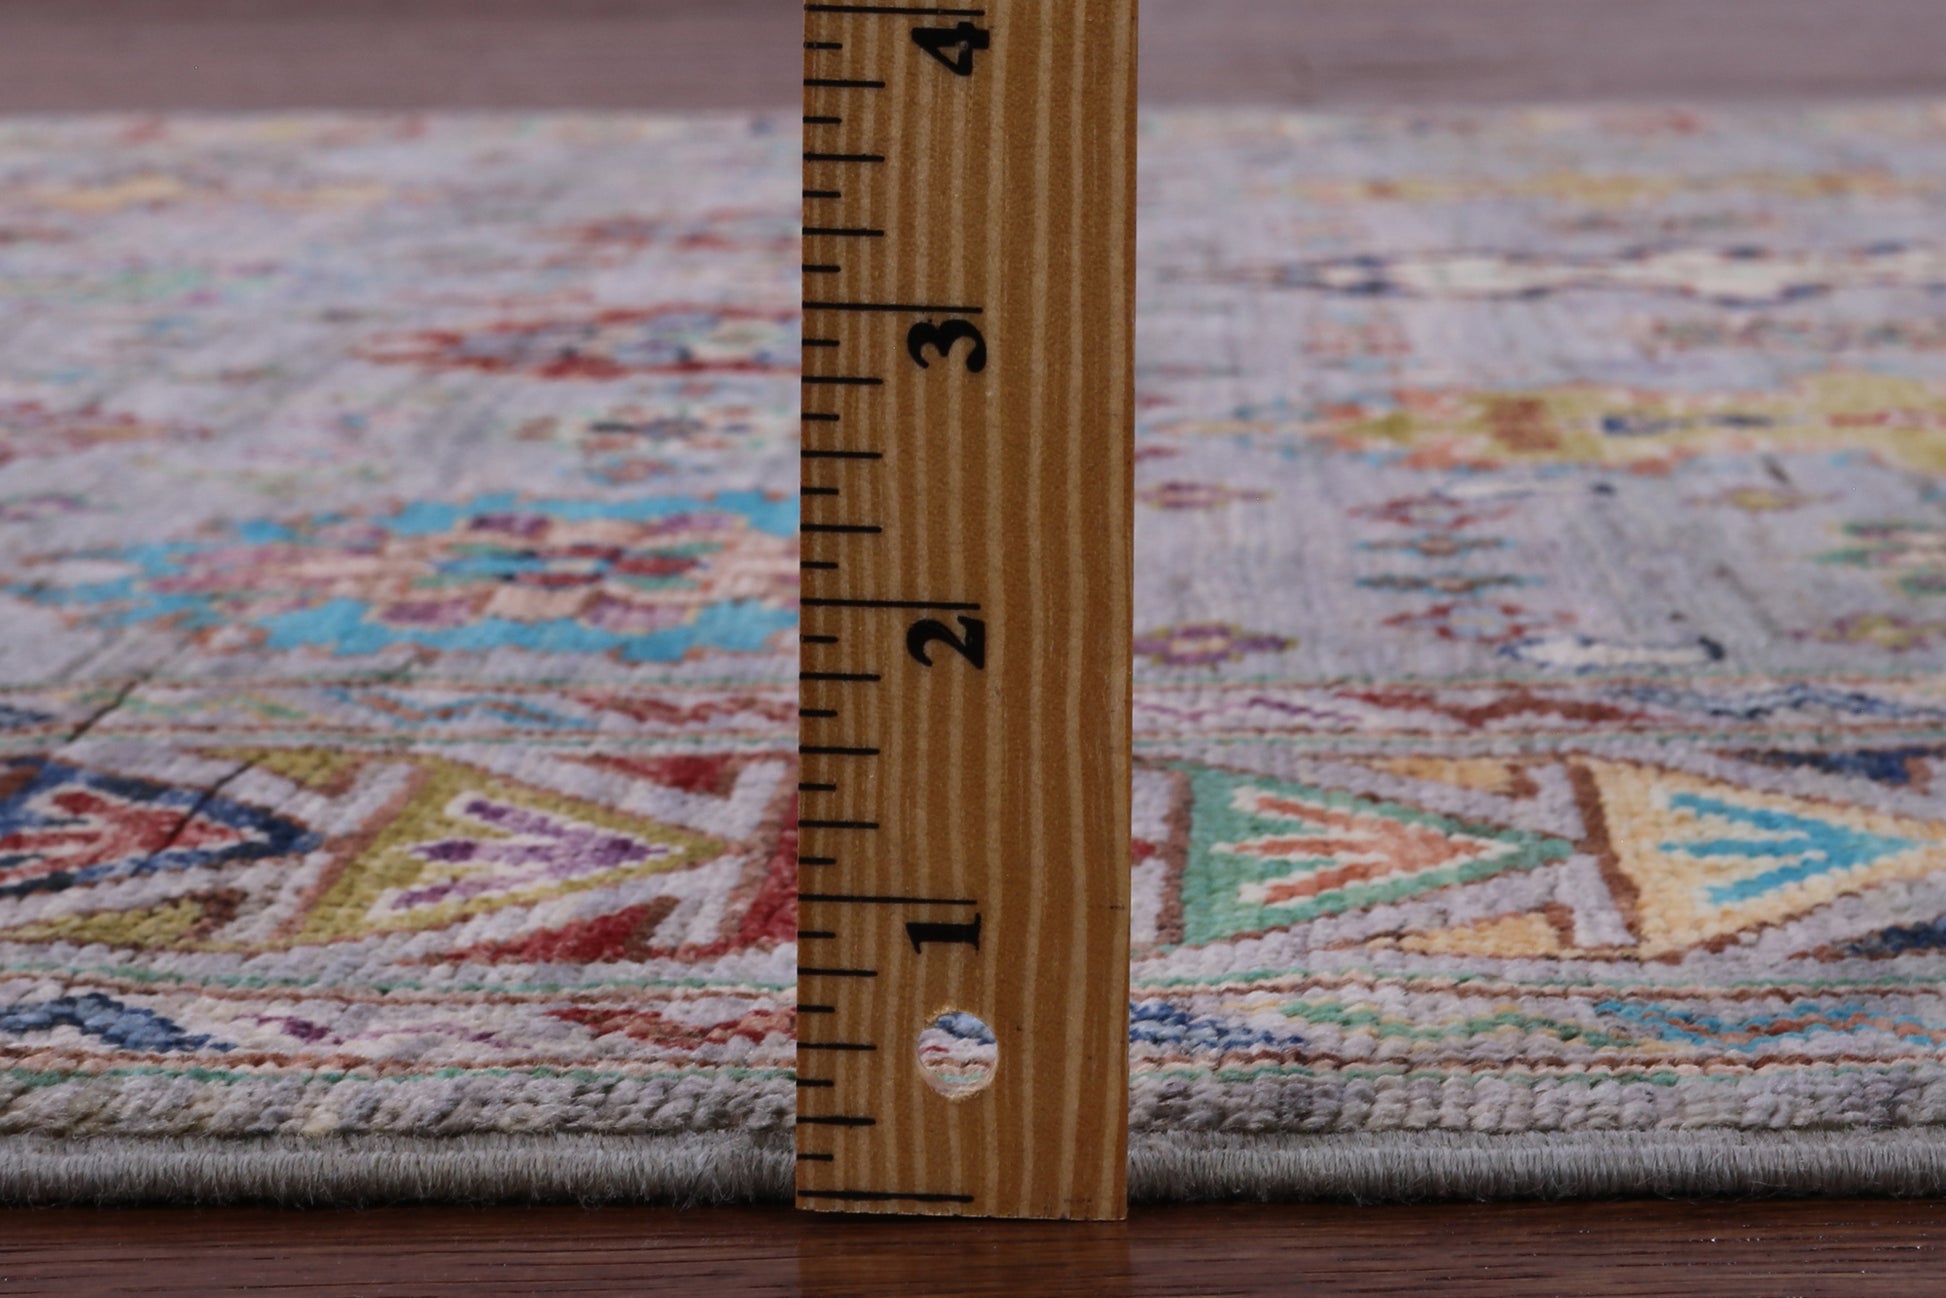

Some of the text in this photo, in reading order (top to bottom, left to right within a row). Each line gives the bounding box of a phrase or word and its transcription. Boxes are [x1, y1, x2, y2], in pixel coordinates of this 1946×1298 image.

[911, 22, 990, 77] 4
[907, 319, 988, 374] 3
[907, 615, 986, 670] 2
[906, 912, 982, 955] 1
